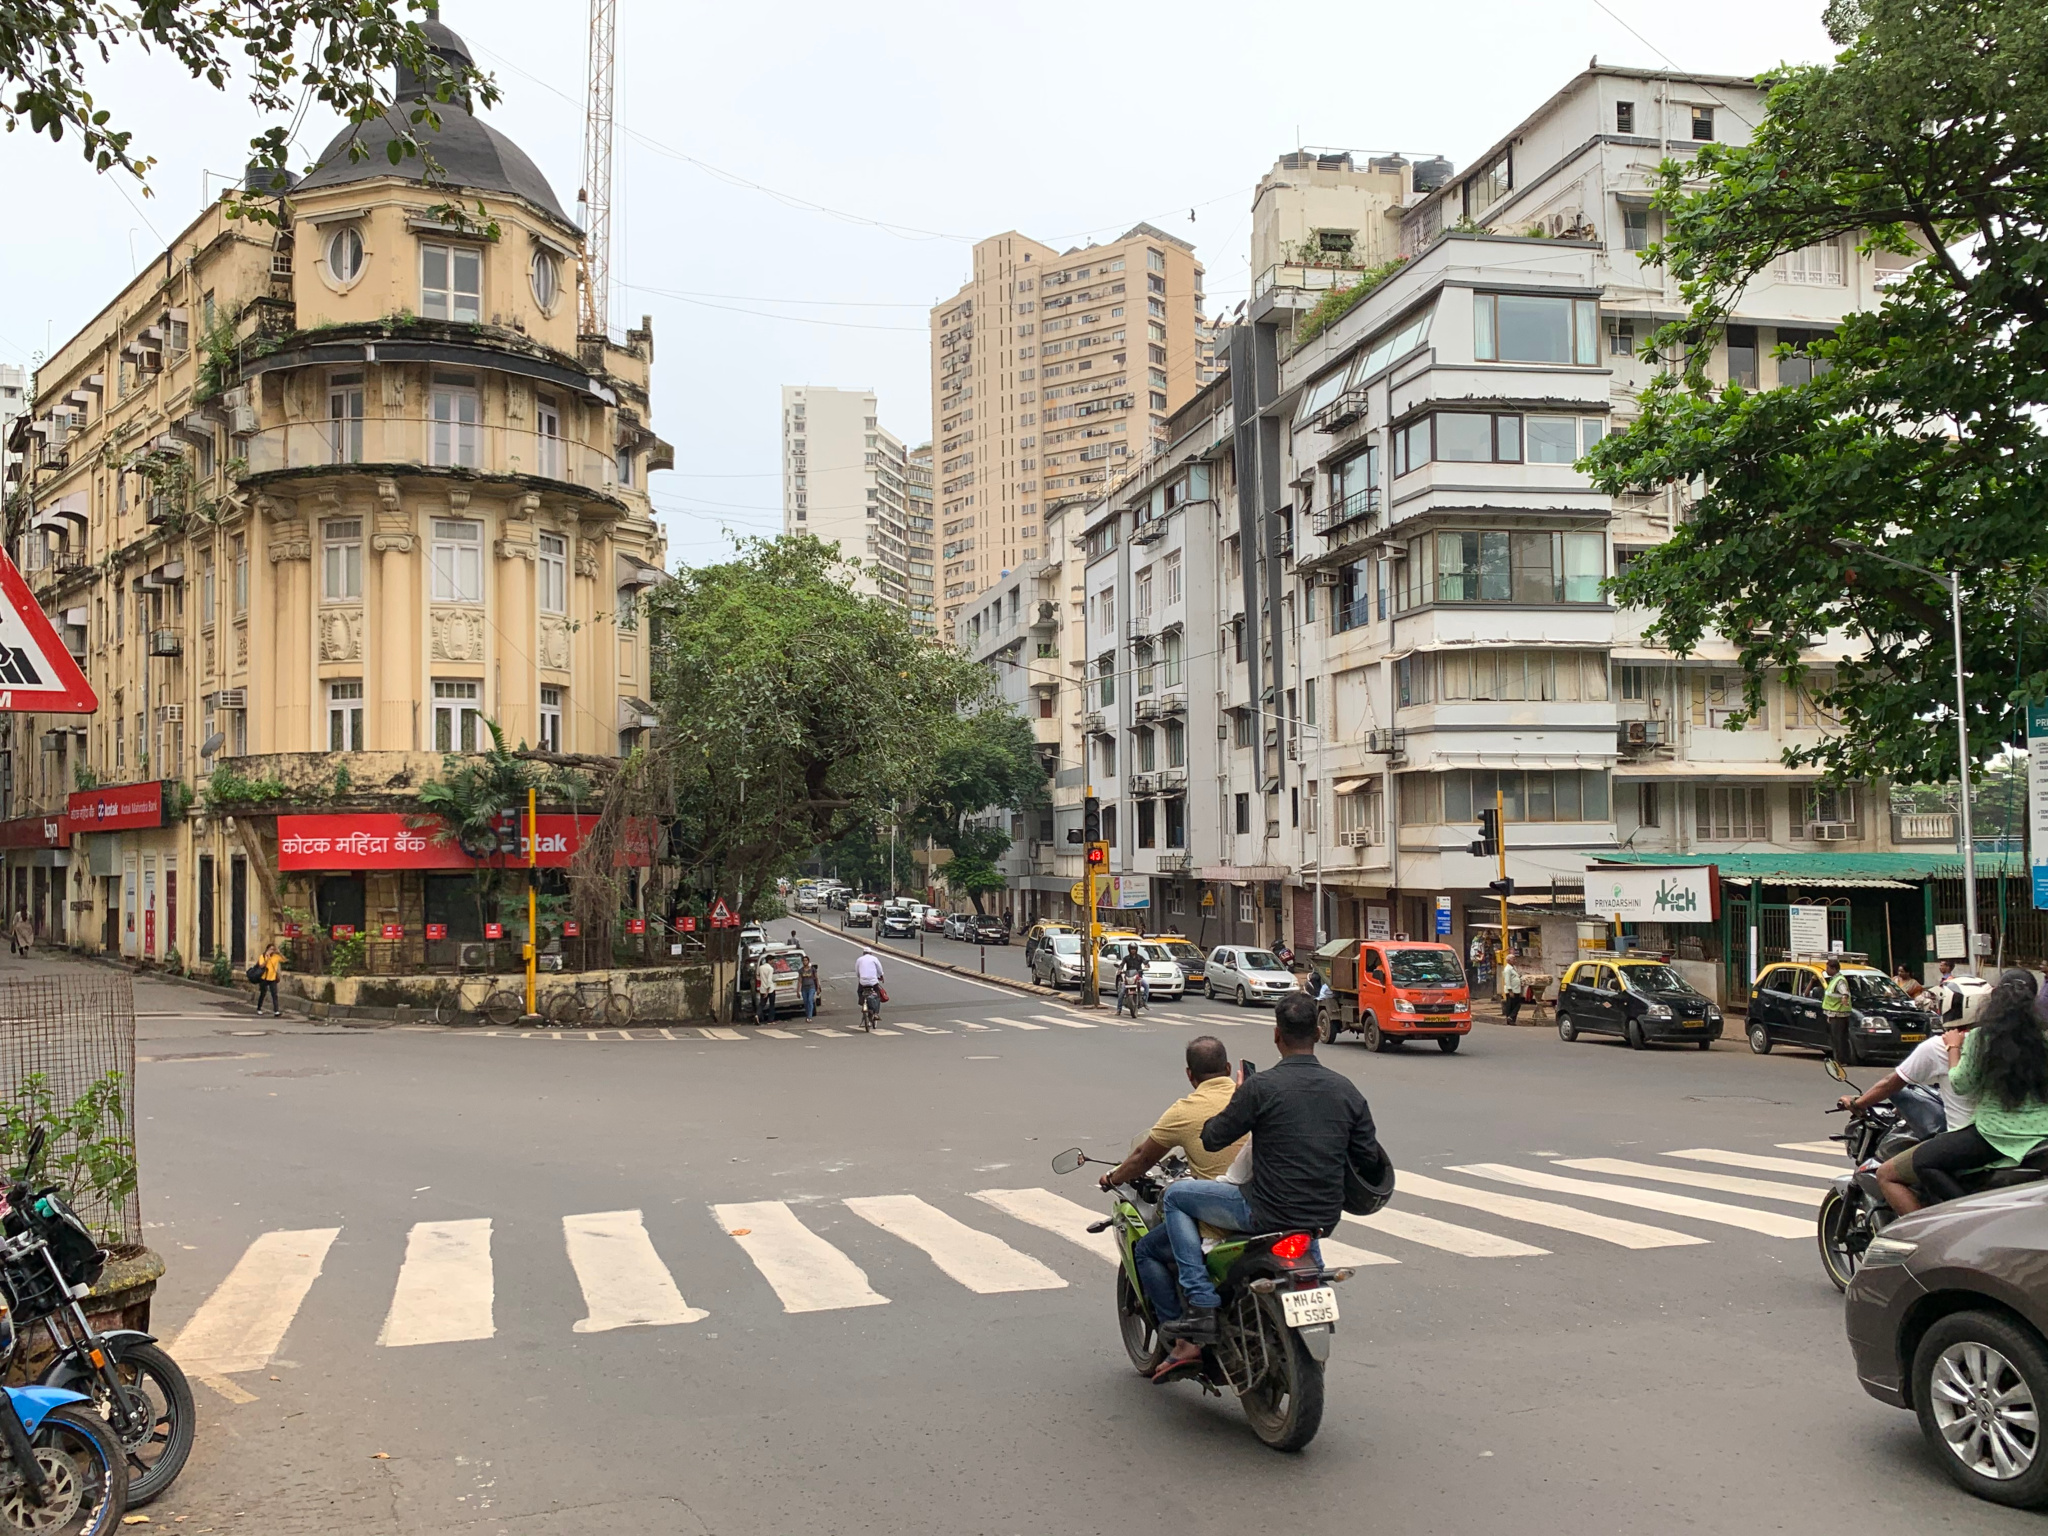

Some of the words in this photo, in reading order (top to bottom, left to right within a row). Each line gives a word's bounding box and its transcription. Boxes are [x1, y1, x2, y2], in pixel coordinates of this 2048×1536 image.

[105, 802, 118, 817] kotak
[44, 818, 58, 845] kaya
[282, 834, 331, 855] कोटक
[335, 831, 389, 856] महिंद्रा
[393, 831, 427, 853] बँक
[520, 833, 568, 853] otak
[1595, 898, 1641, 908] PRIYADARSHINI
[1293, 1293, 1308, 1307] MH
[1310, 1291, 1324, 1304] 46
[1292, 1311, 1299, 1324] T
